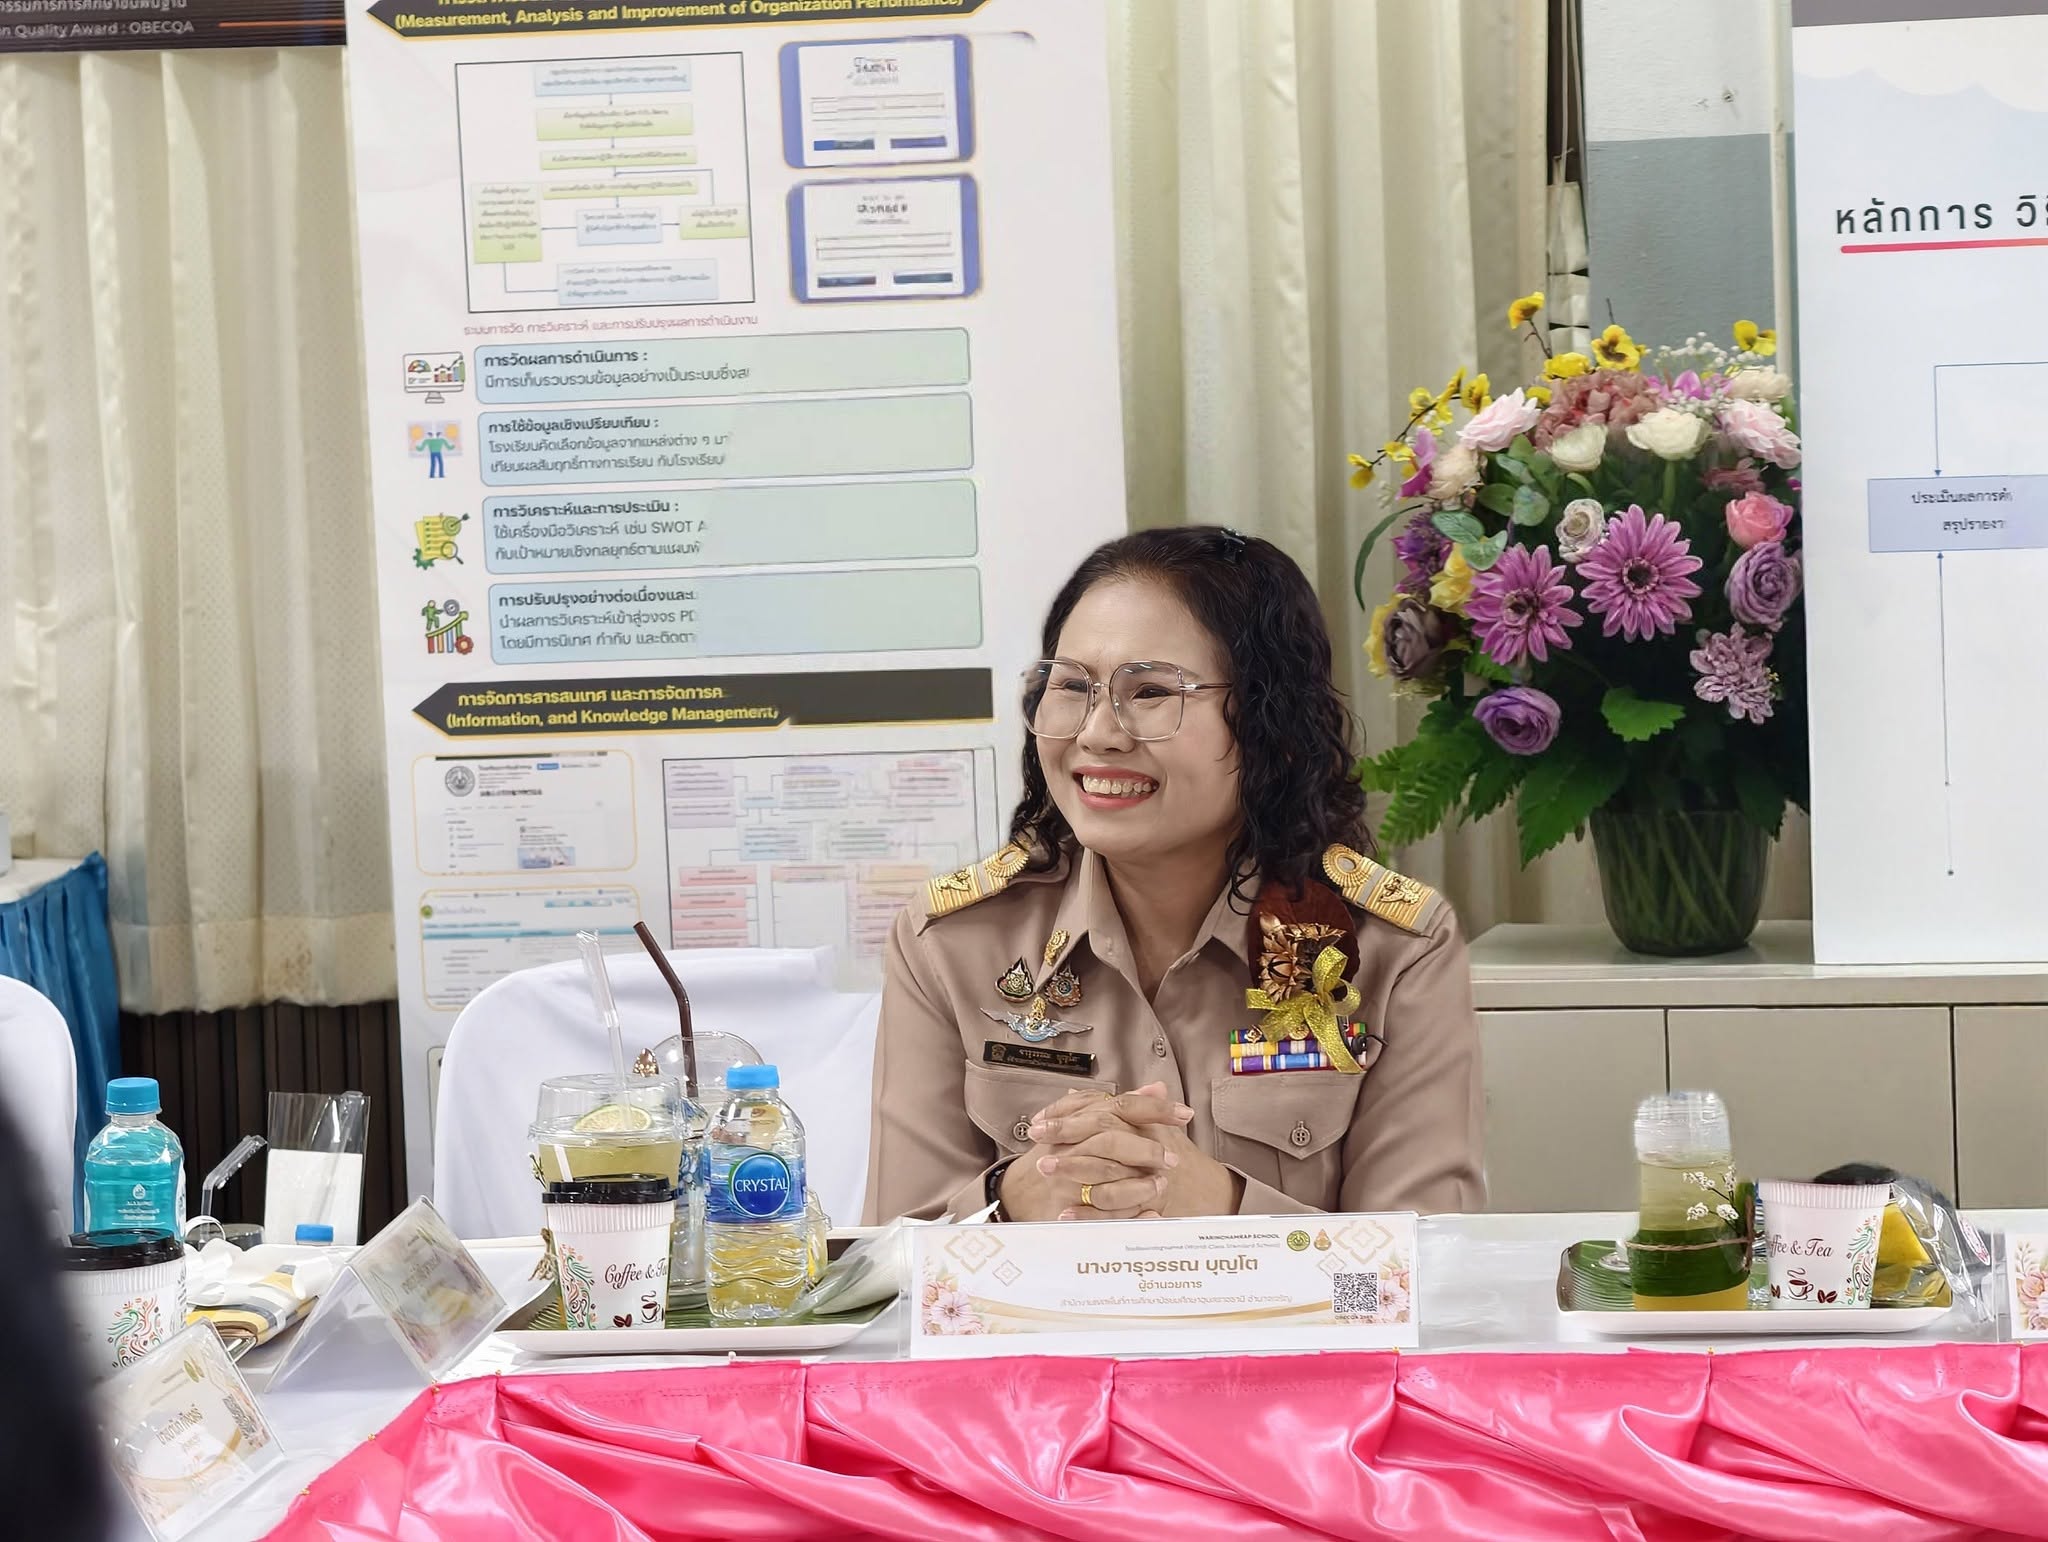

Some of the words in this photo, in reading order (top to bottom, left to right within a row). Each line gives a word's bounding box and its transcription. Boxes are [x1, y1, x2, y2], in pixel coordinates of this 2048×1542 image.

[395, 11, 511, 29] (Measurement,
[515, 7, 584, 25] Analysis
[588, 6, 617, 21] and
[622, 3, 725, 21] Improvement
[729, 1, 747, 15] of
[751, 0, 852, 16] Organization
[15, 24, 68, 39] Quality
[70, 22, 118, 37] Award
[129, 20, 195, 35] OBECQA
[1836, 197, 1993, 234] หลักการ
[2016, 194, 2048, 229] วิ
[484, 350, 639, 367] การวัดผลการดำเนินการ
[488, 416, 650, 435] การใช้ข้อมูลเชิงเปรียบเทียบ
[493, 500, 670, 518] การวิเคราะห์และการประเมิน
[494, 520, 620, 539] ใช้เครื่องมือวิเคราะห์
[624, 520, 647, 535] เช่น
[652, 520, 693, 534] SWOT
[500, 609, 676, 629] นำผลการวิเคราะห์เข้าสู่วงจร
[501, 632, 591, 650] โดยมีการนิเทศ
[597, 631, 631, 645] กำกับ
[458, 689, 607, 707] การจัดการสารสนเทศ
[446, 711, 543, 729] (Information,
[548, 710, 577, 725] and
[582, 708, 668, 724] Knowledge
[735, 1177, 788, 1192] CRYSTAL
[1790, 1240, 1802, 1256] &
[1805, 1238, 1833, 1257] Tea
[1077, 1259, 1199, 1277] นางจารุวรรณ
[1206, 1255, 1258, 1275] บุญโต
[605, 1263, 642, 1290] Coffee
[645, 1264, 655, 1279] &
[1138, 1279, 1203, 1292] ผู้อำนวยการ
